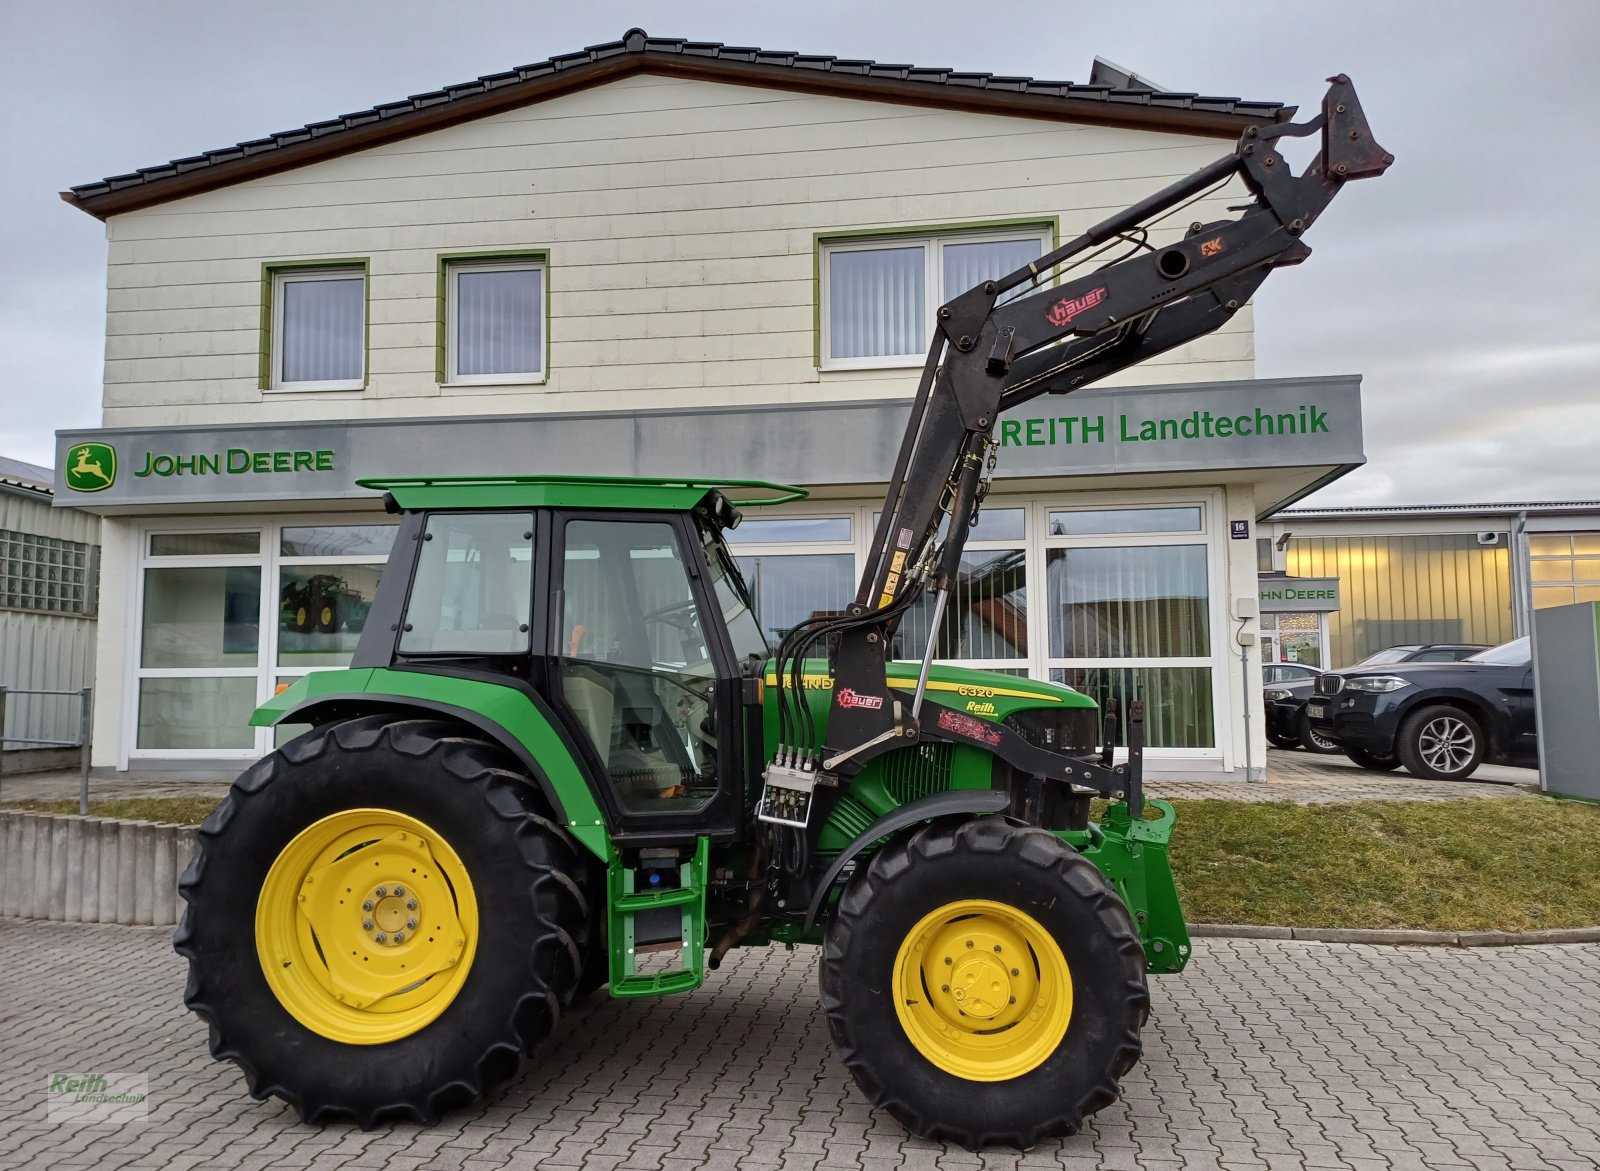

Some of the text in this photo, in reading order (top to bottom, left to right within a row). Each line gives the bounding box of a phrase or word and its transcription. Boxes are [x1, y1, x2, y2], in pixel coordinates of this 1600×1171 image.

[1053, 287, 1107, 320] hauer
[1001, 405, 1329, 447] REITH Landtechnik
[134, 448, 335, 478] JOHN DEERE
[1235, 522, 1245, 531] 16
[1260, 588, 1336, 600] HN DEERE
[958, 685, 994, 698] 6320
[843, 691, 879, 707] hauer
[966, 701, 995, 713] Reith
